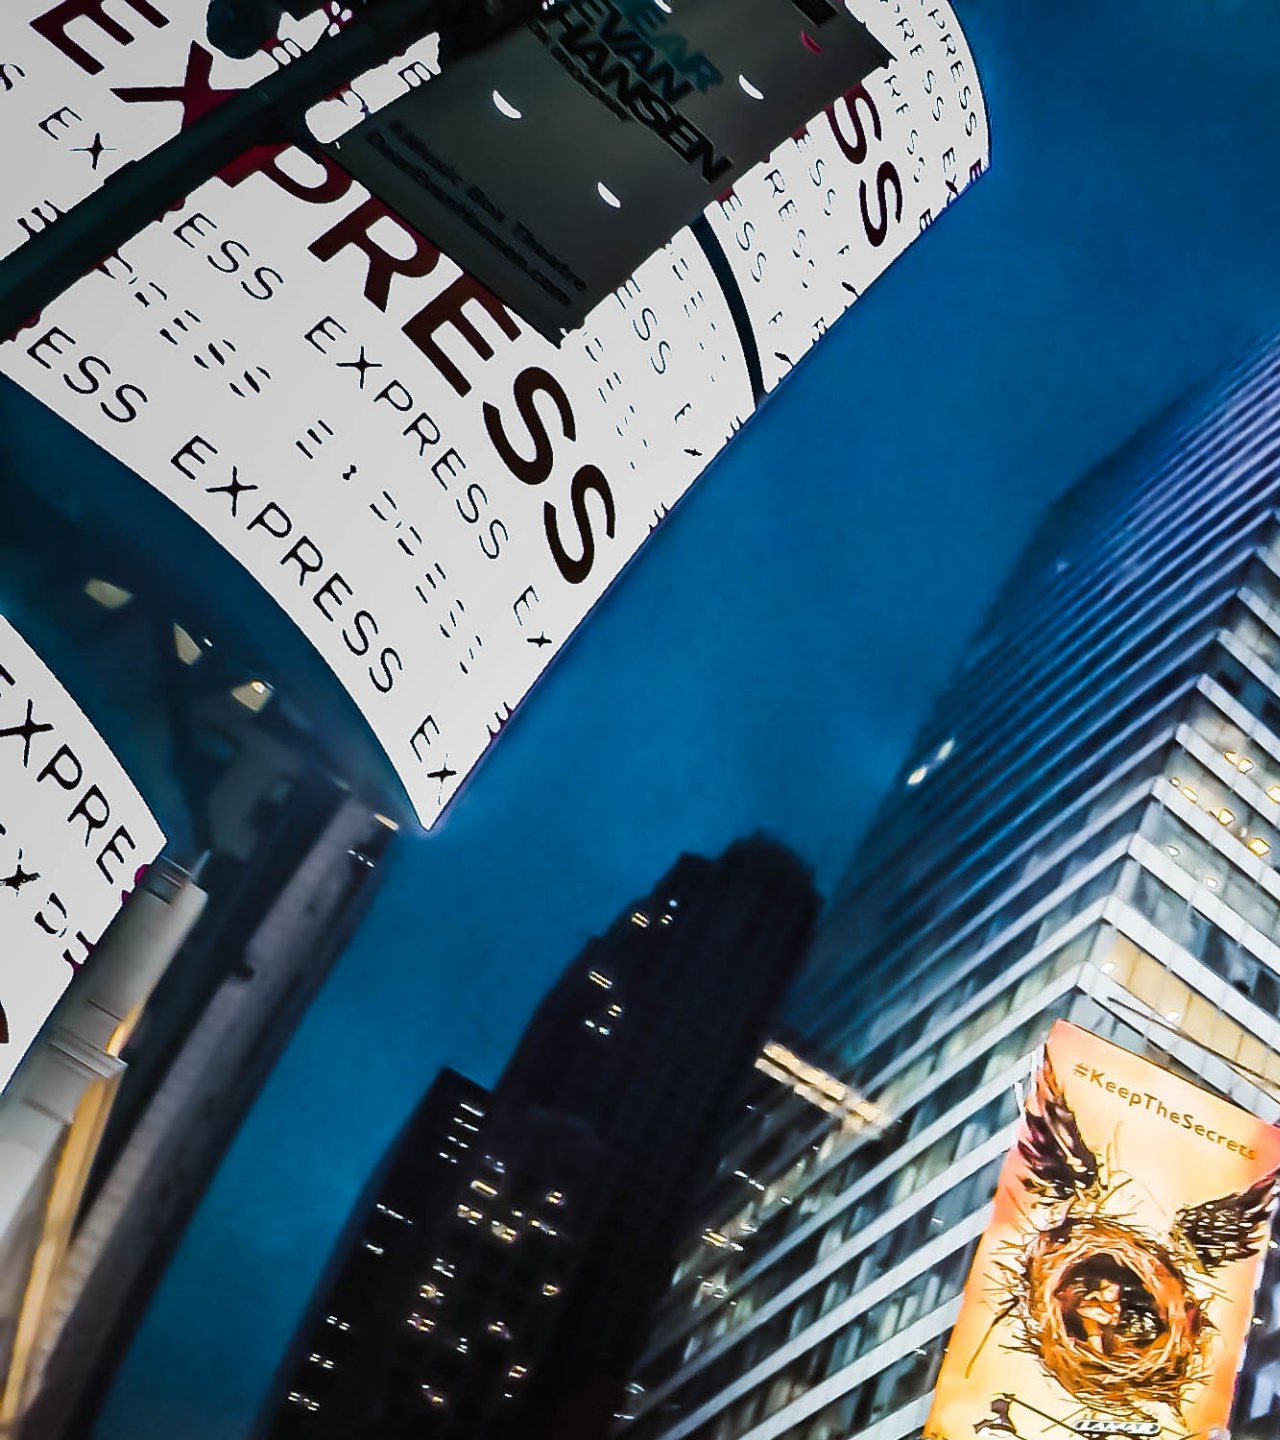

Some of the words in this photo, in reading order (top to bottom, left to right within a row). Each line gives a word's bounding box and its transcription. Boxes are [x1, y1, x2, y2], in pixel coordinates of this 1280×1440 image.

[304, 315, 509, 560] EXPRESS
[170, 434, 404, 694] EXPRESS
[1071, 1060, 1259, 1162] #KeepTheSecrets
